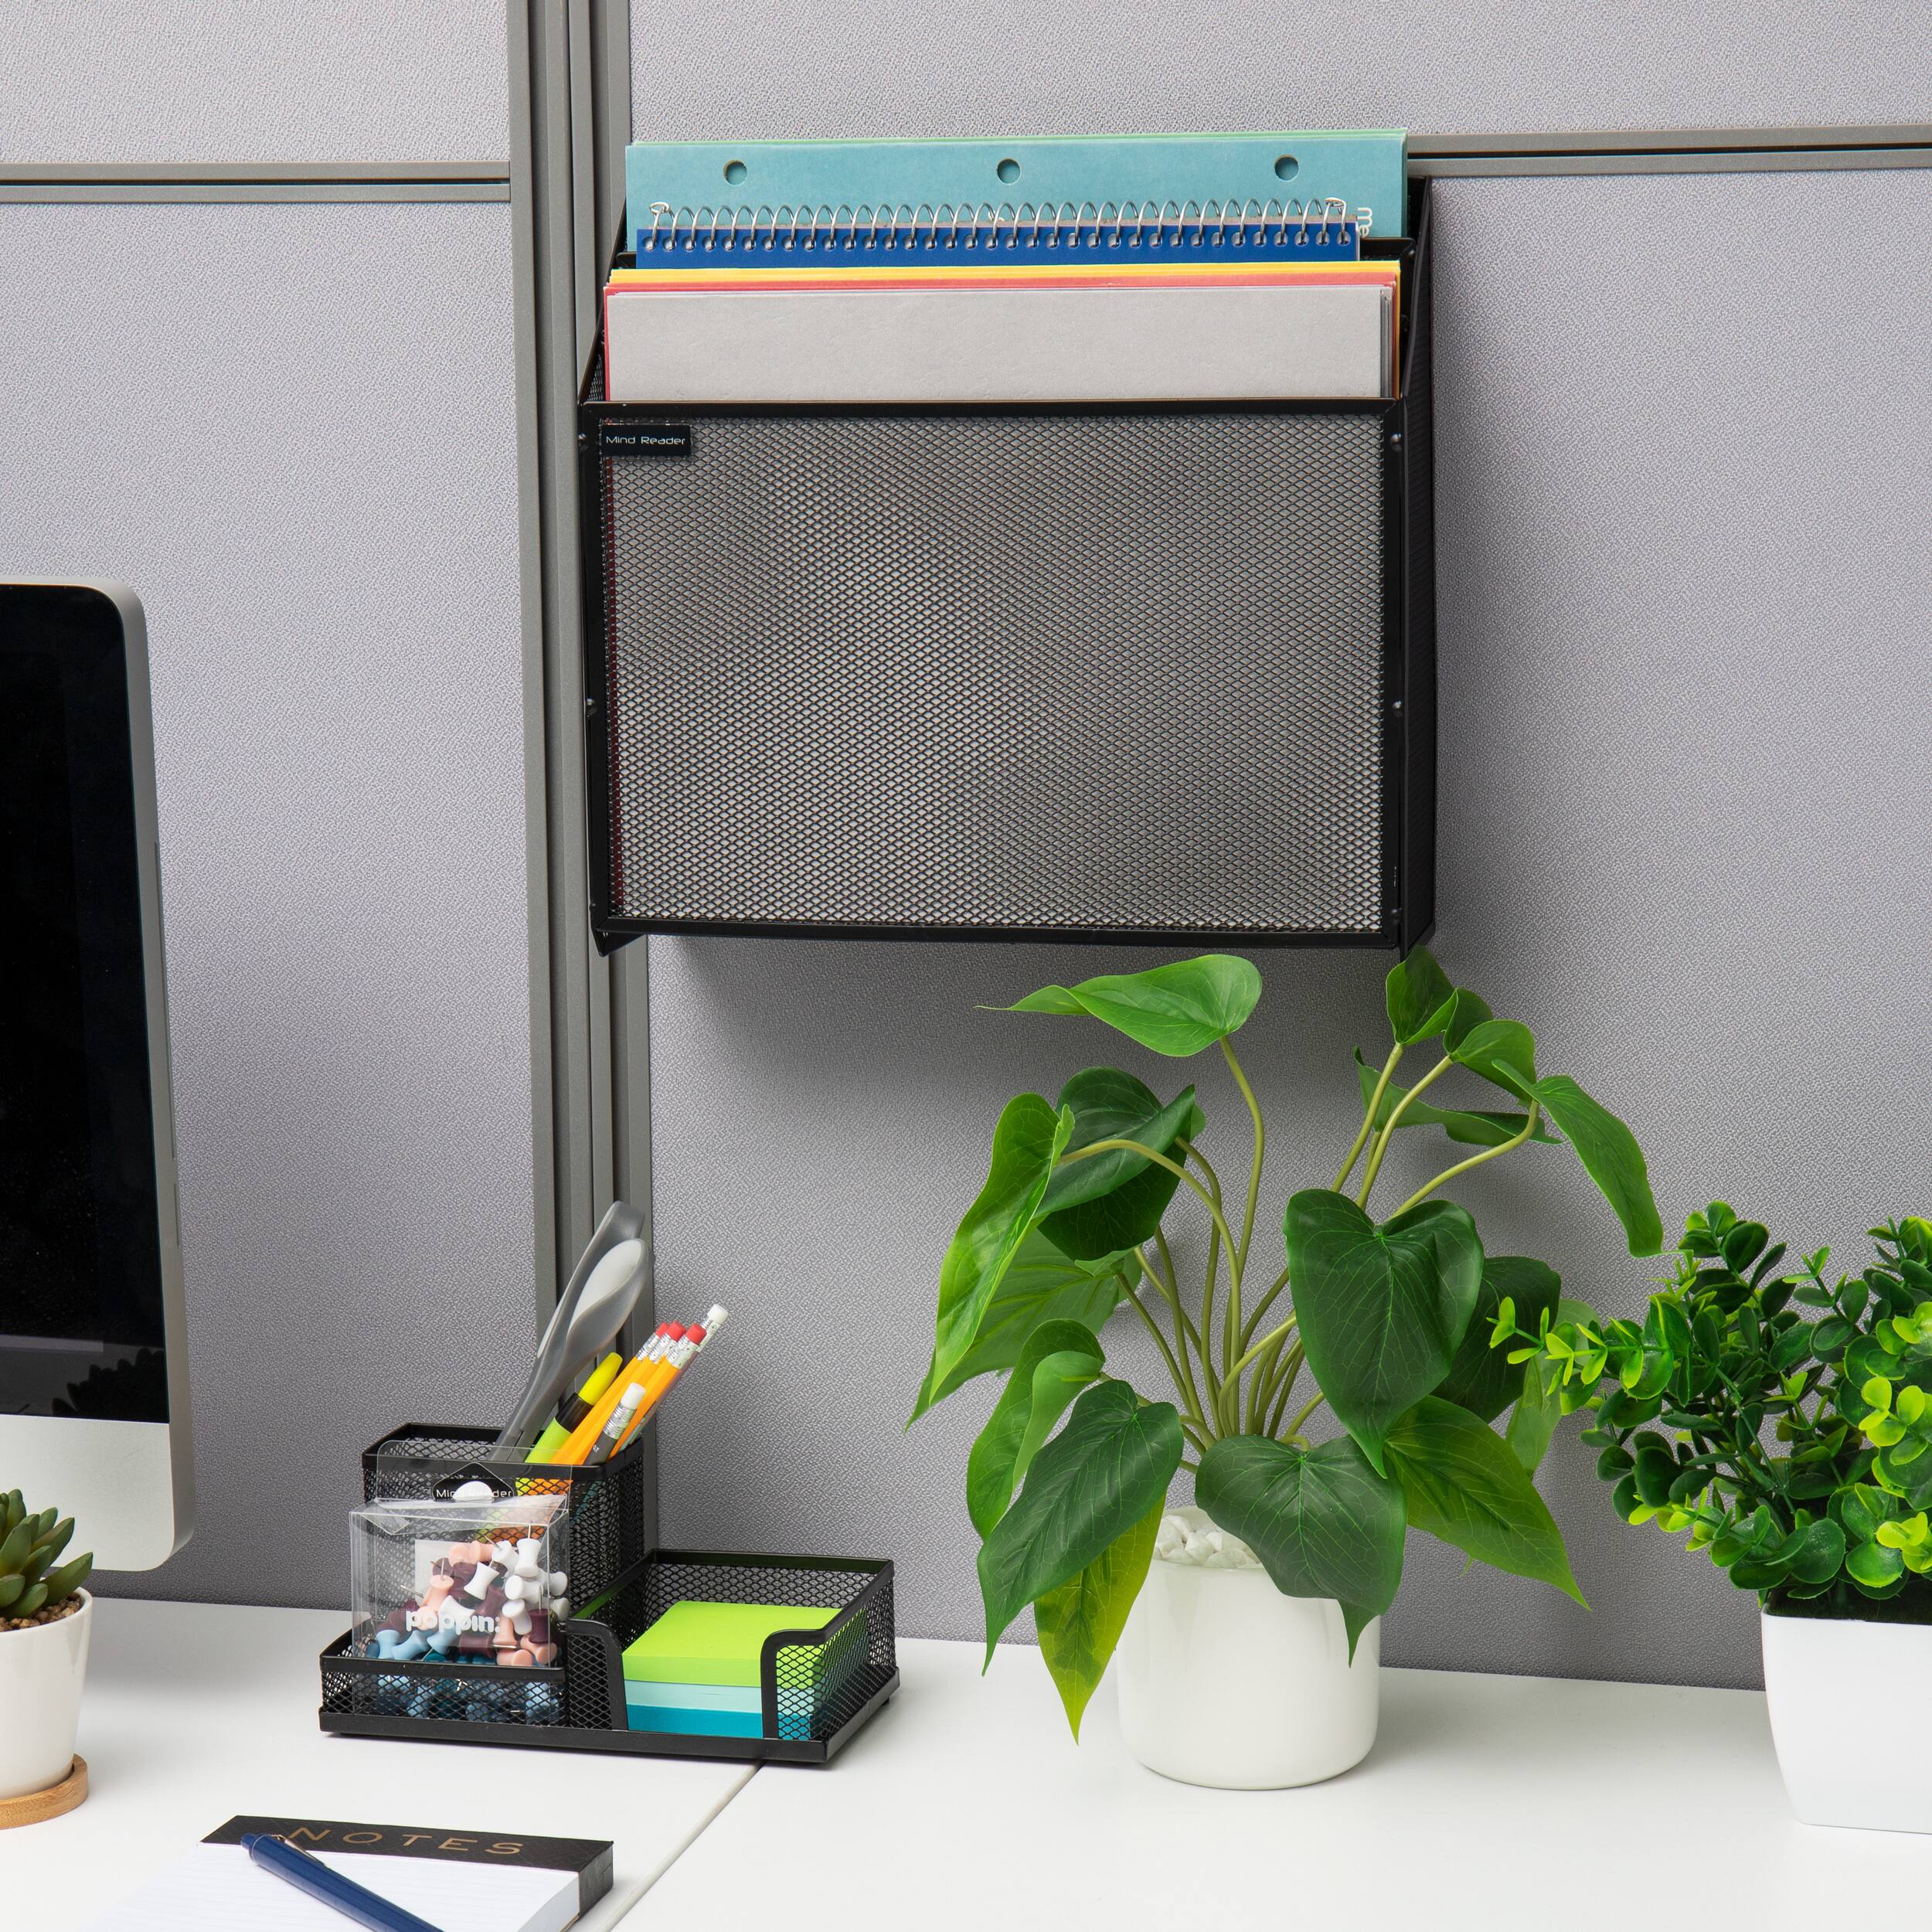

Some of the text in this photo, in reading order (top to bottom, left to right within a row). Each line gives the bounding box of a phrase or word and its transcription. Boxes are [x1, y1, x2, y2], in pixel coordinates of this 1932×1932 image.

[606, 436, 685, 445] Mind Reader
[286, 1827, 524, 1855] NOTES
